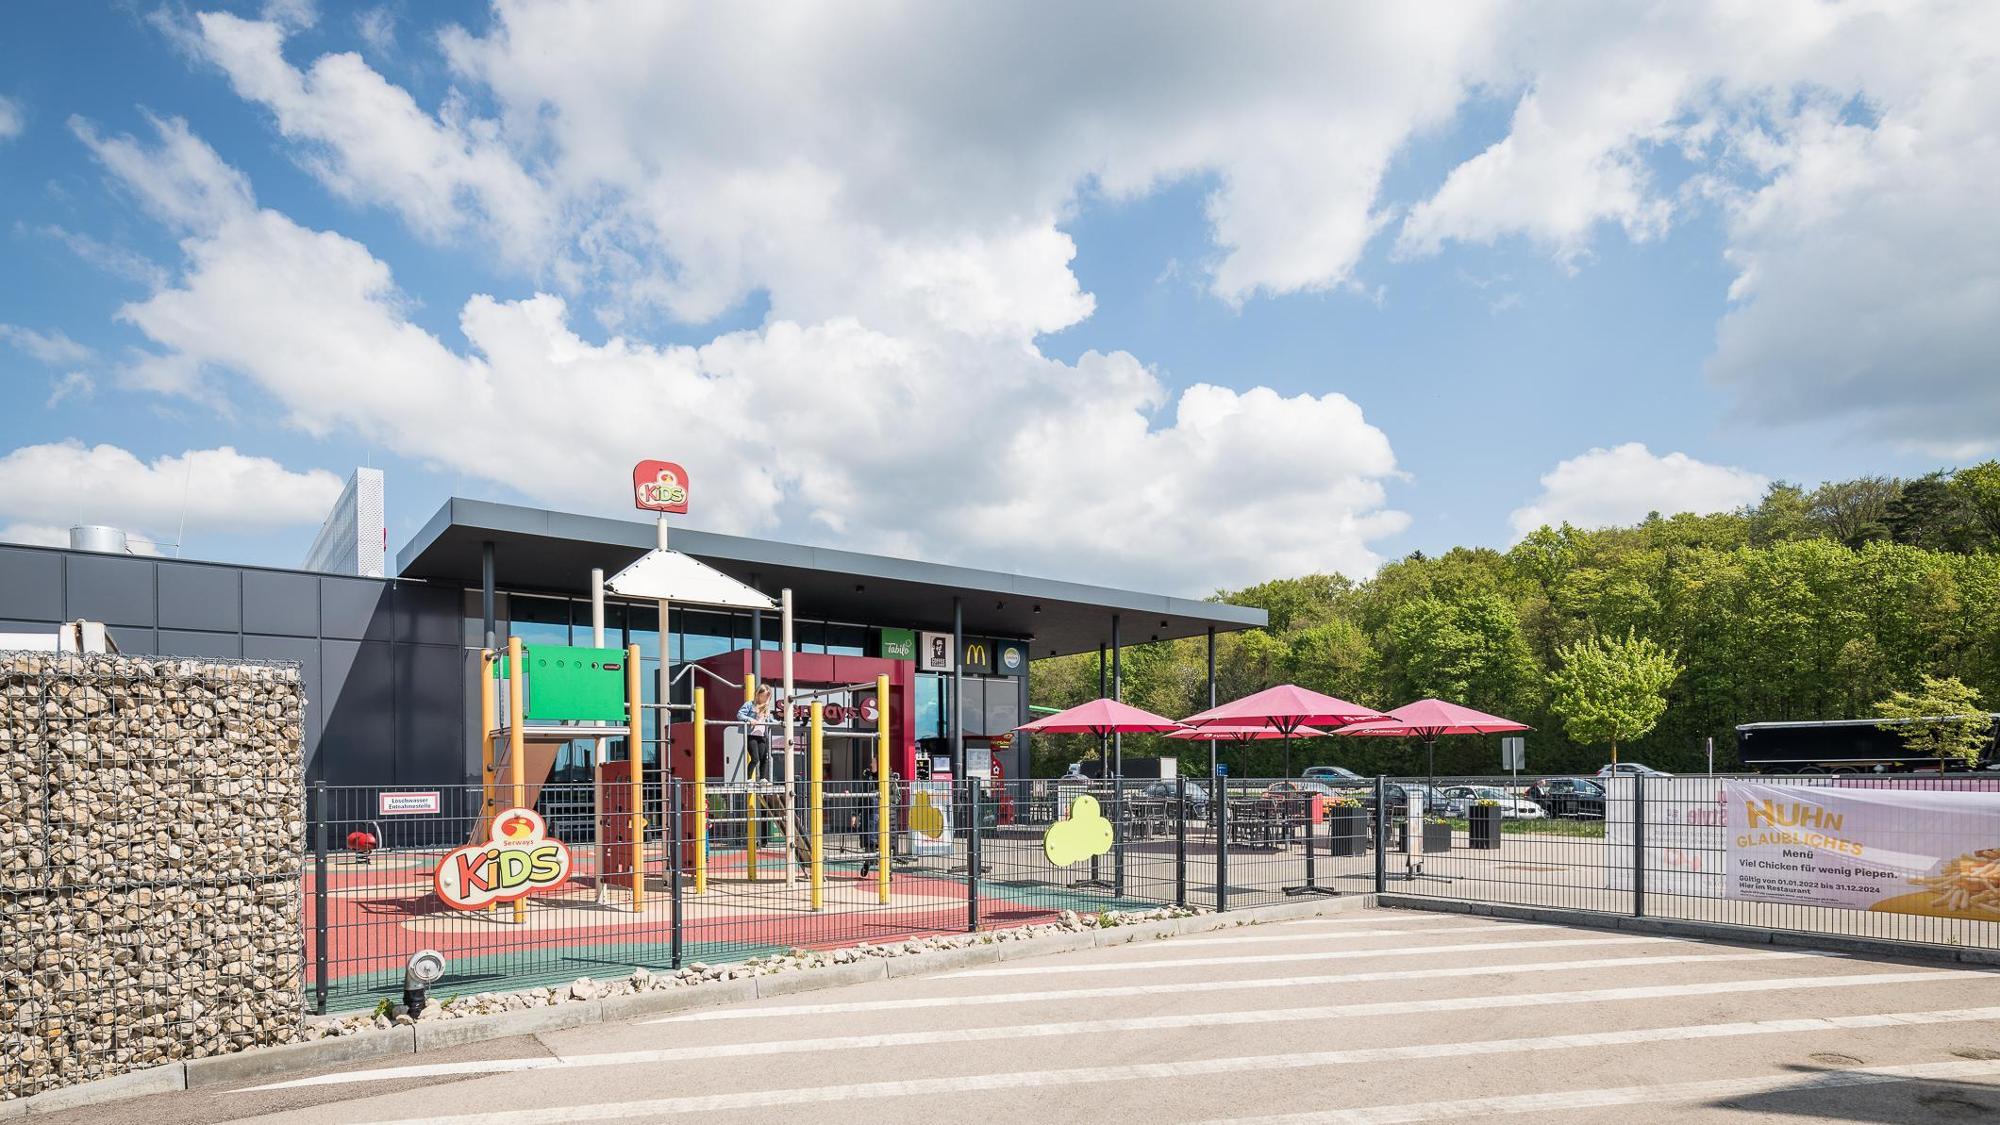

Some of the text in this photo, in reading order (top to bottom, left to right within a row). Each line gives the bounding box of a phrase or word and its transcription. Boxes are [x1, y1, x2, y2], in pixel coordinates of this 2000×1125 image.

[504, 839, 534, 848] Serways
[1737, 831, 1863, 856] GLAUBLICHES
[1782, 849, 1814, 859] Menü
[1739, 859, 1898, 879] Viel Chicken für wenig Piepen.
[1739, 875, 1761, 884] Gültig
[1778, 879, 1819, 888] 01.01.2022
[1820, 882, 1834, 890] bis
[1835, 884, 1880, 893] 31.12.2024
[1767, 884, 1811, 895] Restaurant
